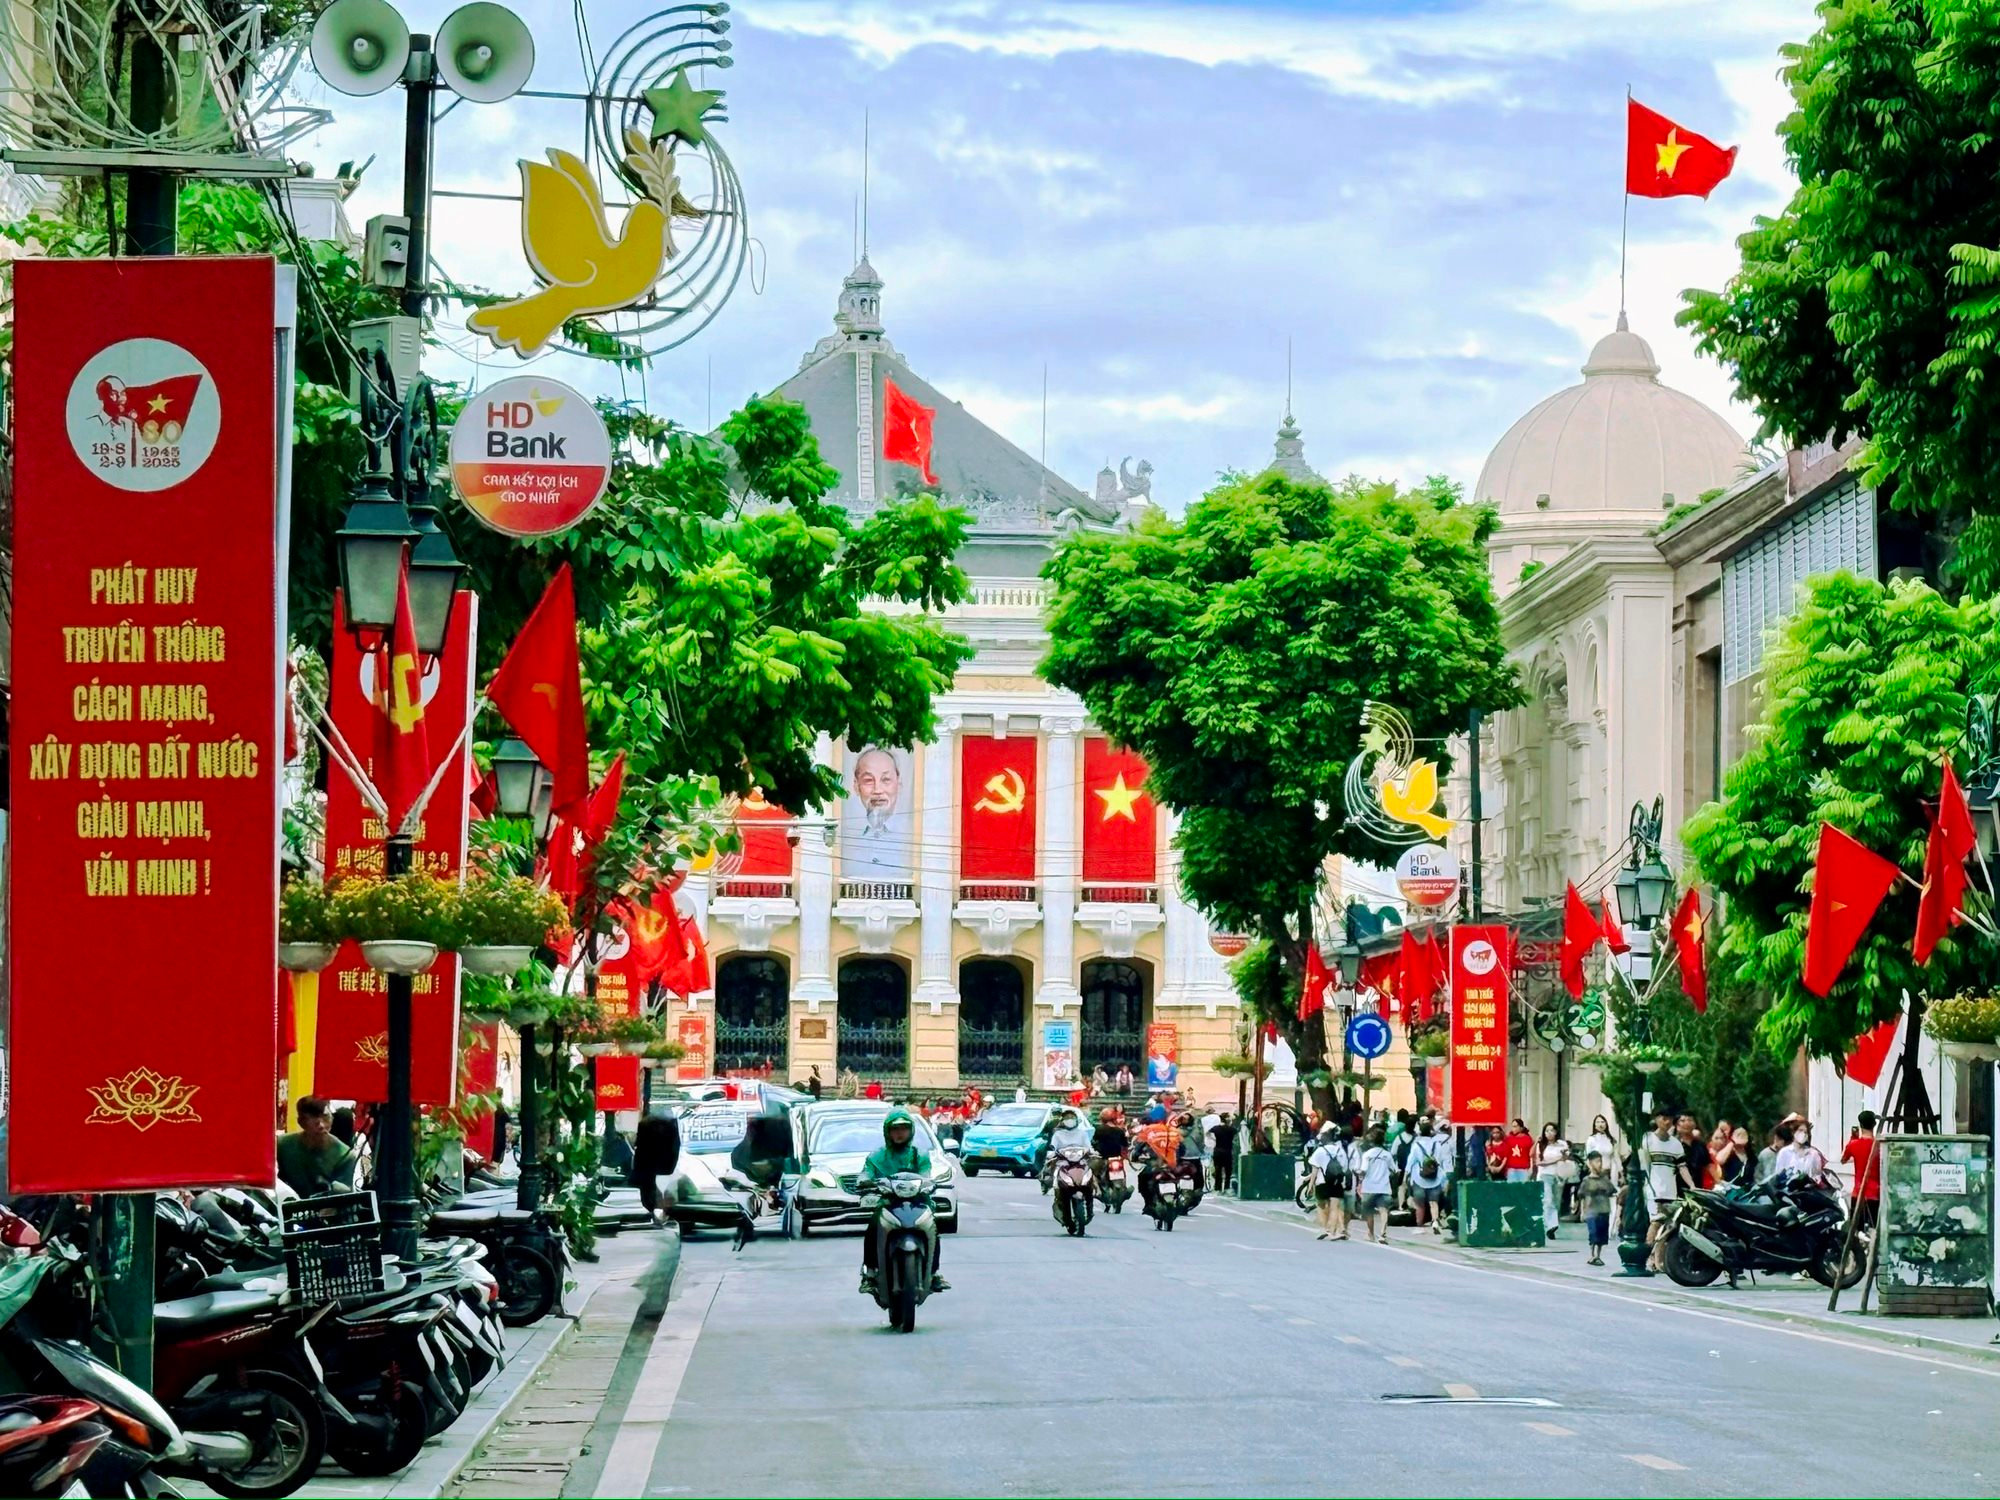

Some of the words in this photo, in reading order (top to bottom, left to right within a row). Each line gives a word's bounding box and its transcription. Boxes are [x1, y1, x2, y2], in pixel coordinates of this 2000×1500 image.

[487, 401, 534, 429] HD
[142, 420, 182, 444] 80
[487, 431, 567, 459] Bank
[142, 446, 180, 457] 1945
[142, 457, 181, 468] 2025
[483, 474, 510, 486] CAM
[559, 473, 579, 488] ÍCH
[500, 490, 527, 503] CAO
[528, 488, 560, 504] NHẤT
[90, 560, 147, 604] PHÁT
[154, 567, 198, 604] HUY
[62, 618, 146, 663] TRUYỀN
[152, 618, 226, 663] THỐNG
[73, 676, 132, 721] CÁCH
[140, 684, 215, 729] MẠNG,
[29, 734, 72, 780] XÂY
[79, 740, 141, 787] DỰNG
[148, 734, 191, 779] ĐẤT
[198, 733, 259, 779] NƯỚC
[77, 794, 129, 839] GIÀU
[136, 801, 212, 845] MẠNH,
[85, 851, 129, 897] VĂN
[136, 859, 197, 897] MINH
[1410, 854, 1429, 866] HD
[1410, 866, 1441, 876] Bank
[338, 966, 359, 992] THẾ
[361, 967, 376, 997] HỆ
[411, 973, 433, 994] AM
